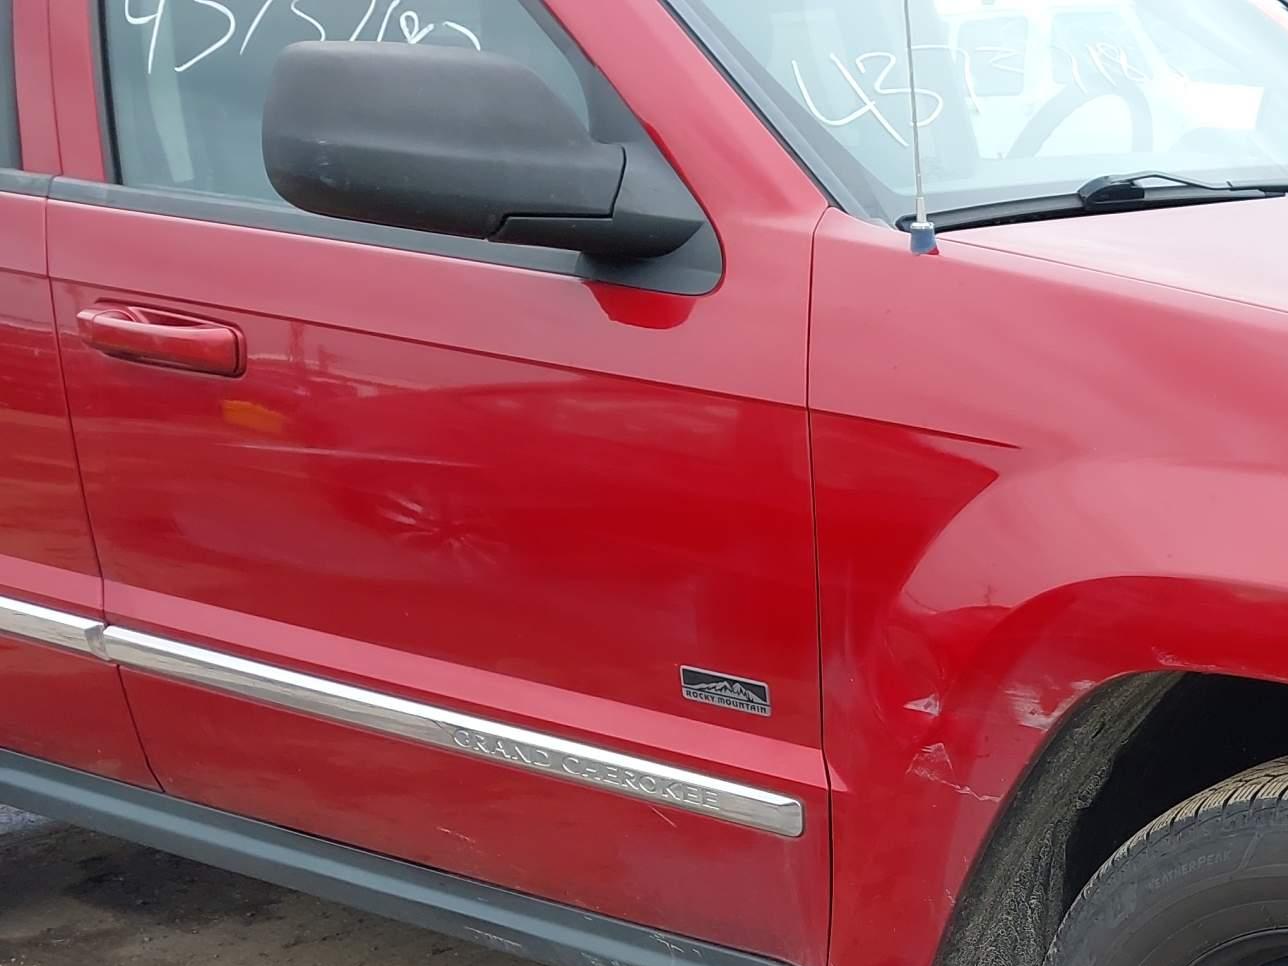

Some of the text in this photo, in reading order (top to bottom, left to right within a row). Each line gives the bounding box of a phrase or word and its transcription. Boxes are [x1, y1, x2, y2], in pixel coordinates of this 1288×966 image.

[685, 690, 767, 714] ROCKY MOUNTAIN
[452, 728, 721, 811] GRAND CHEROKEE
